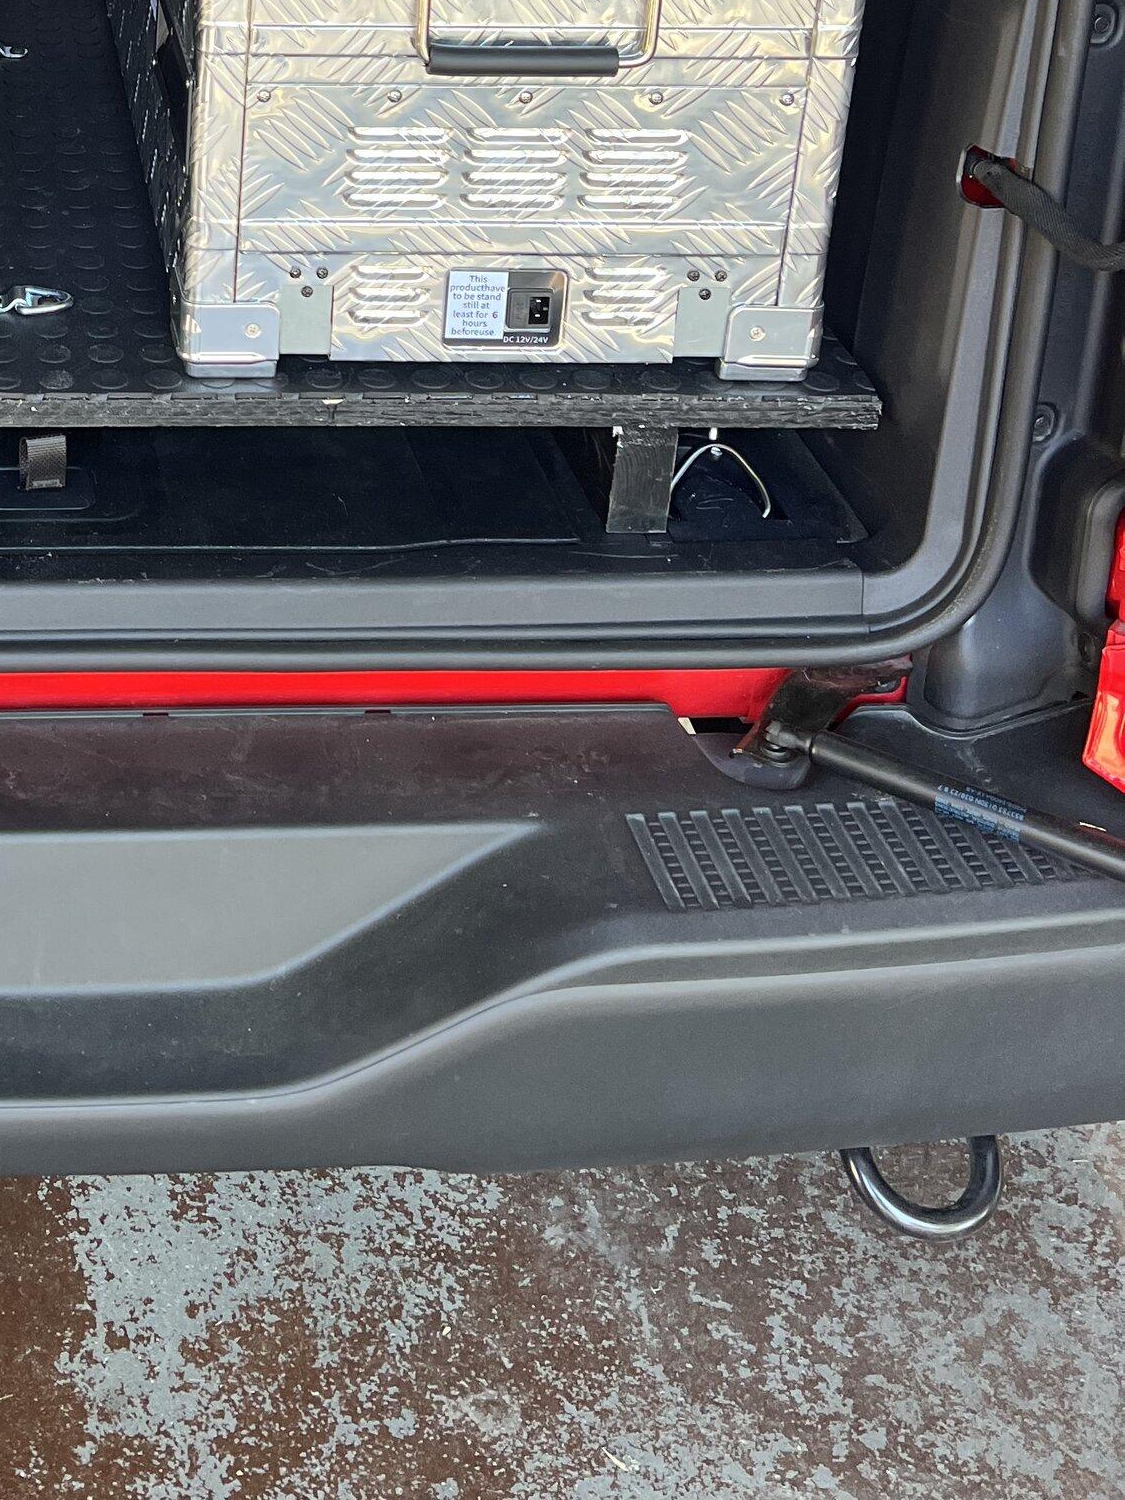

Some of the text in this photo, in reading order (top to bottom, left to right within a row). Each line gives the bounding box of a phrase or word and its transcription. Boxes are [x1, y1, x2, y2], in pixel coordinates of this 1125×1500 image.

[469, 274, 488, 283] This
[453, 292, 501, 301] to be stand
[463, 301, 479, 309] still
[453, 310, 498, 319] least for 6
[462, 319, 488, 327] hours
[503, 335, 549, 344] DC 12V/24V
